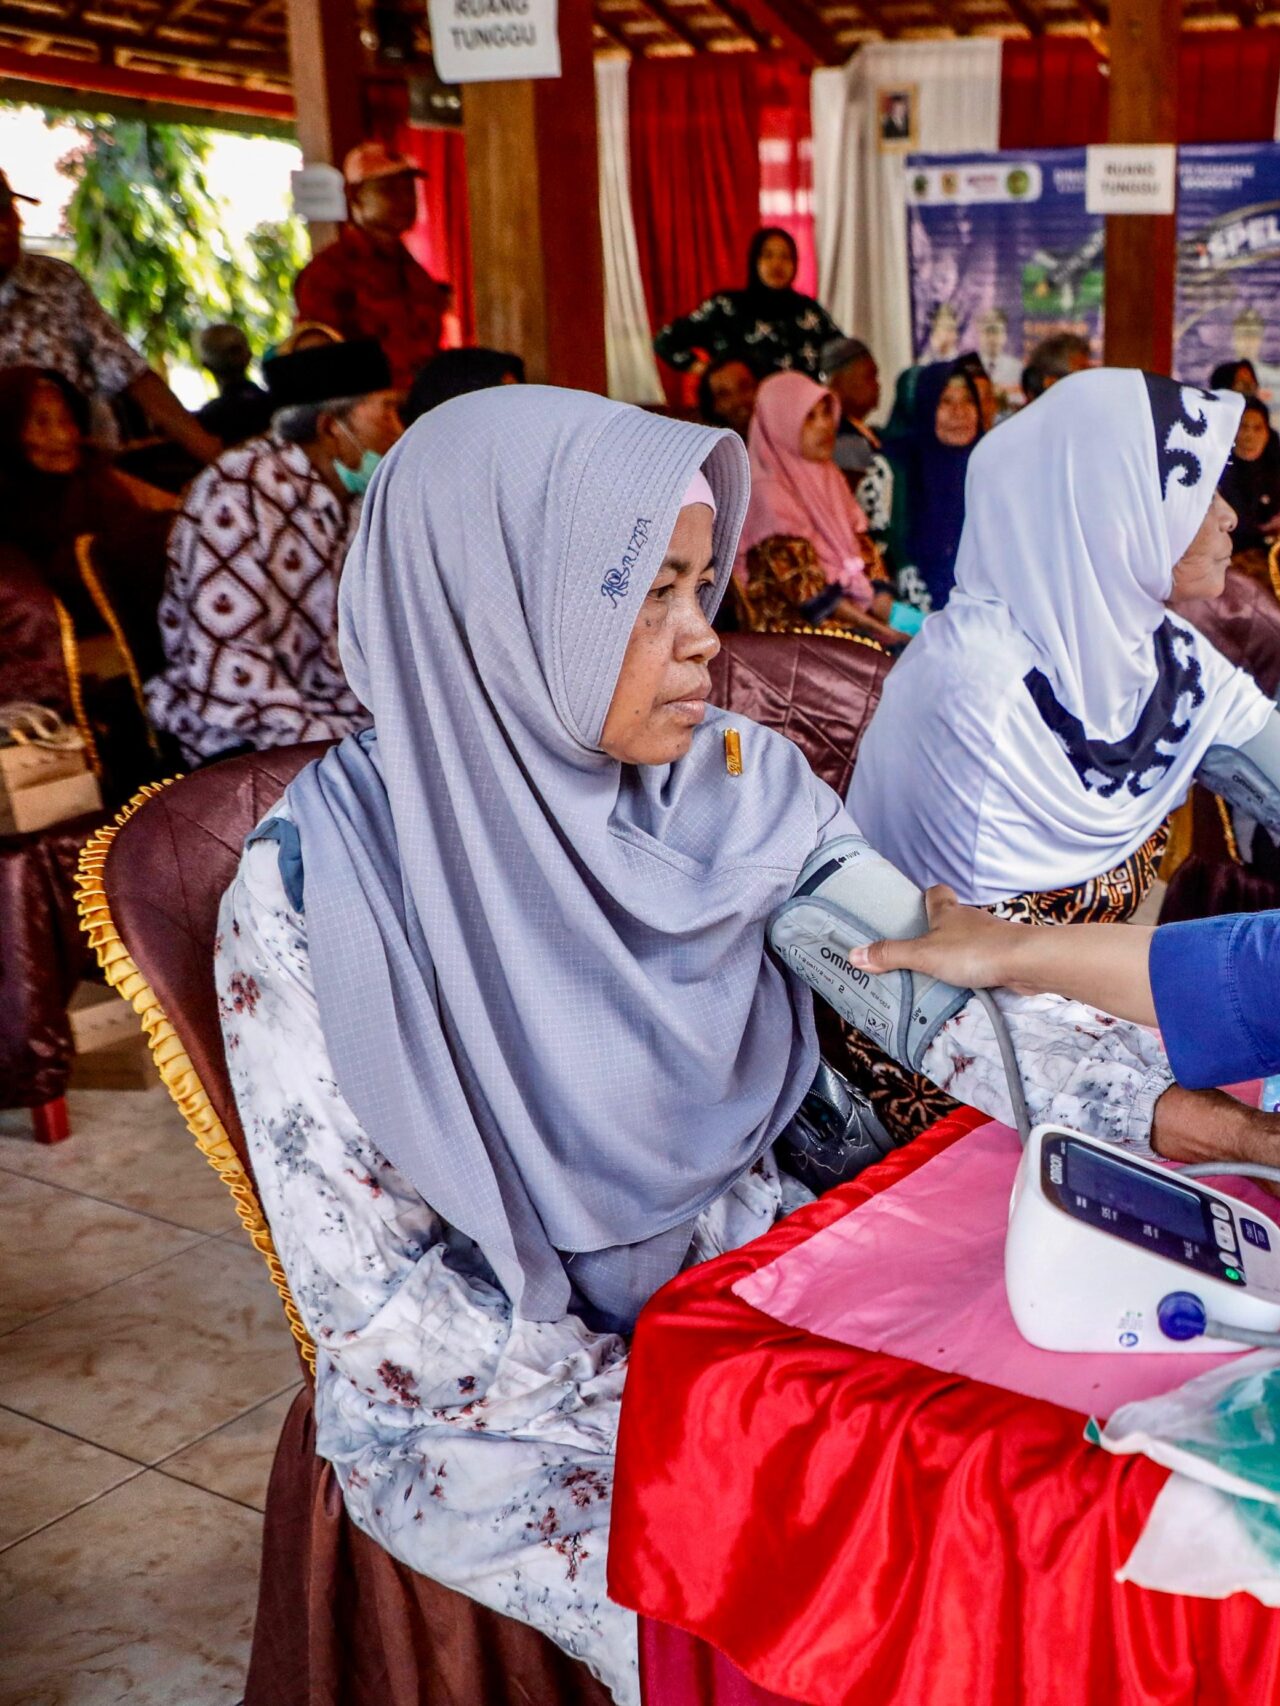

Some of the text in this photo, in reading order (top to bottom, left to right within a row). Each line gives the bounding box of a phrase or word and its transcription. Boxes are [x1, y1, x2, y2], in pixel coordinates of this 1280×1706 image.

[453, 0, 530, 18] RUANG
[451, 24, 537, 50] TUNGGU
[1104, 162, 1156, 177] RUANG
[820, 946, 870, 989] OMRON
[1049, 1153, 1063, 1185] OMRON
